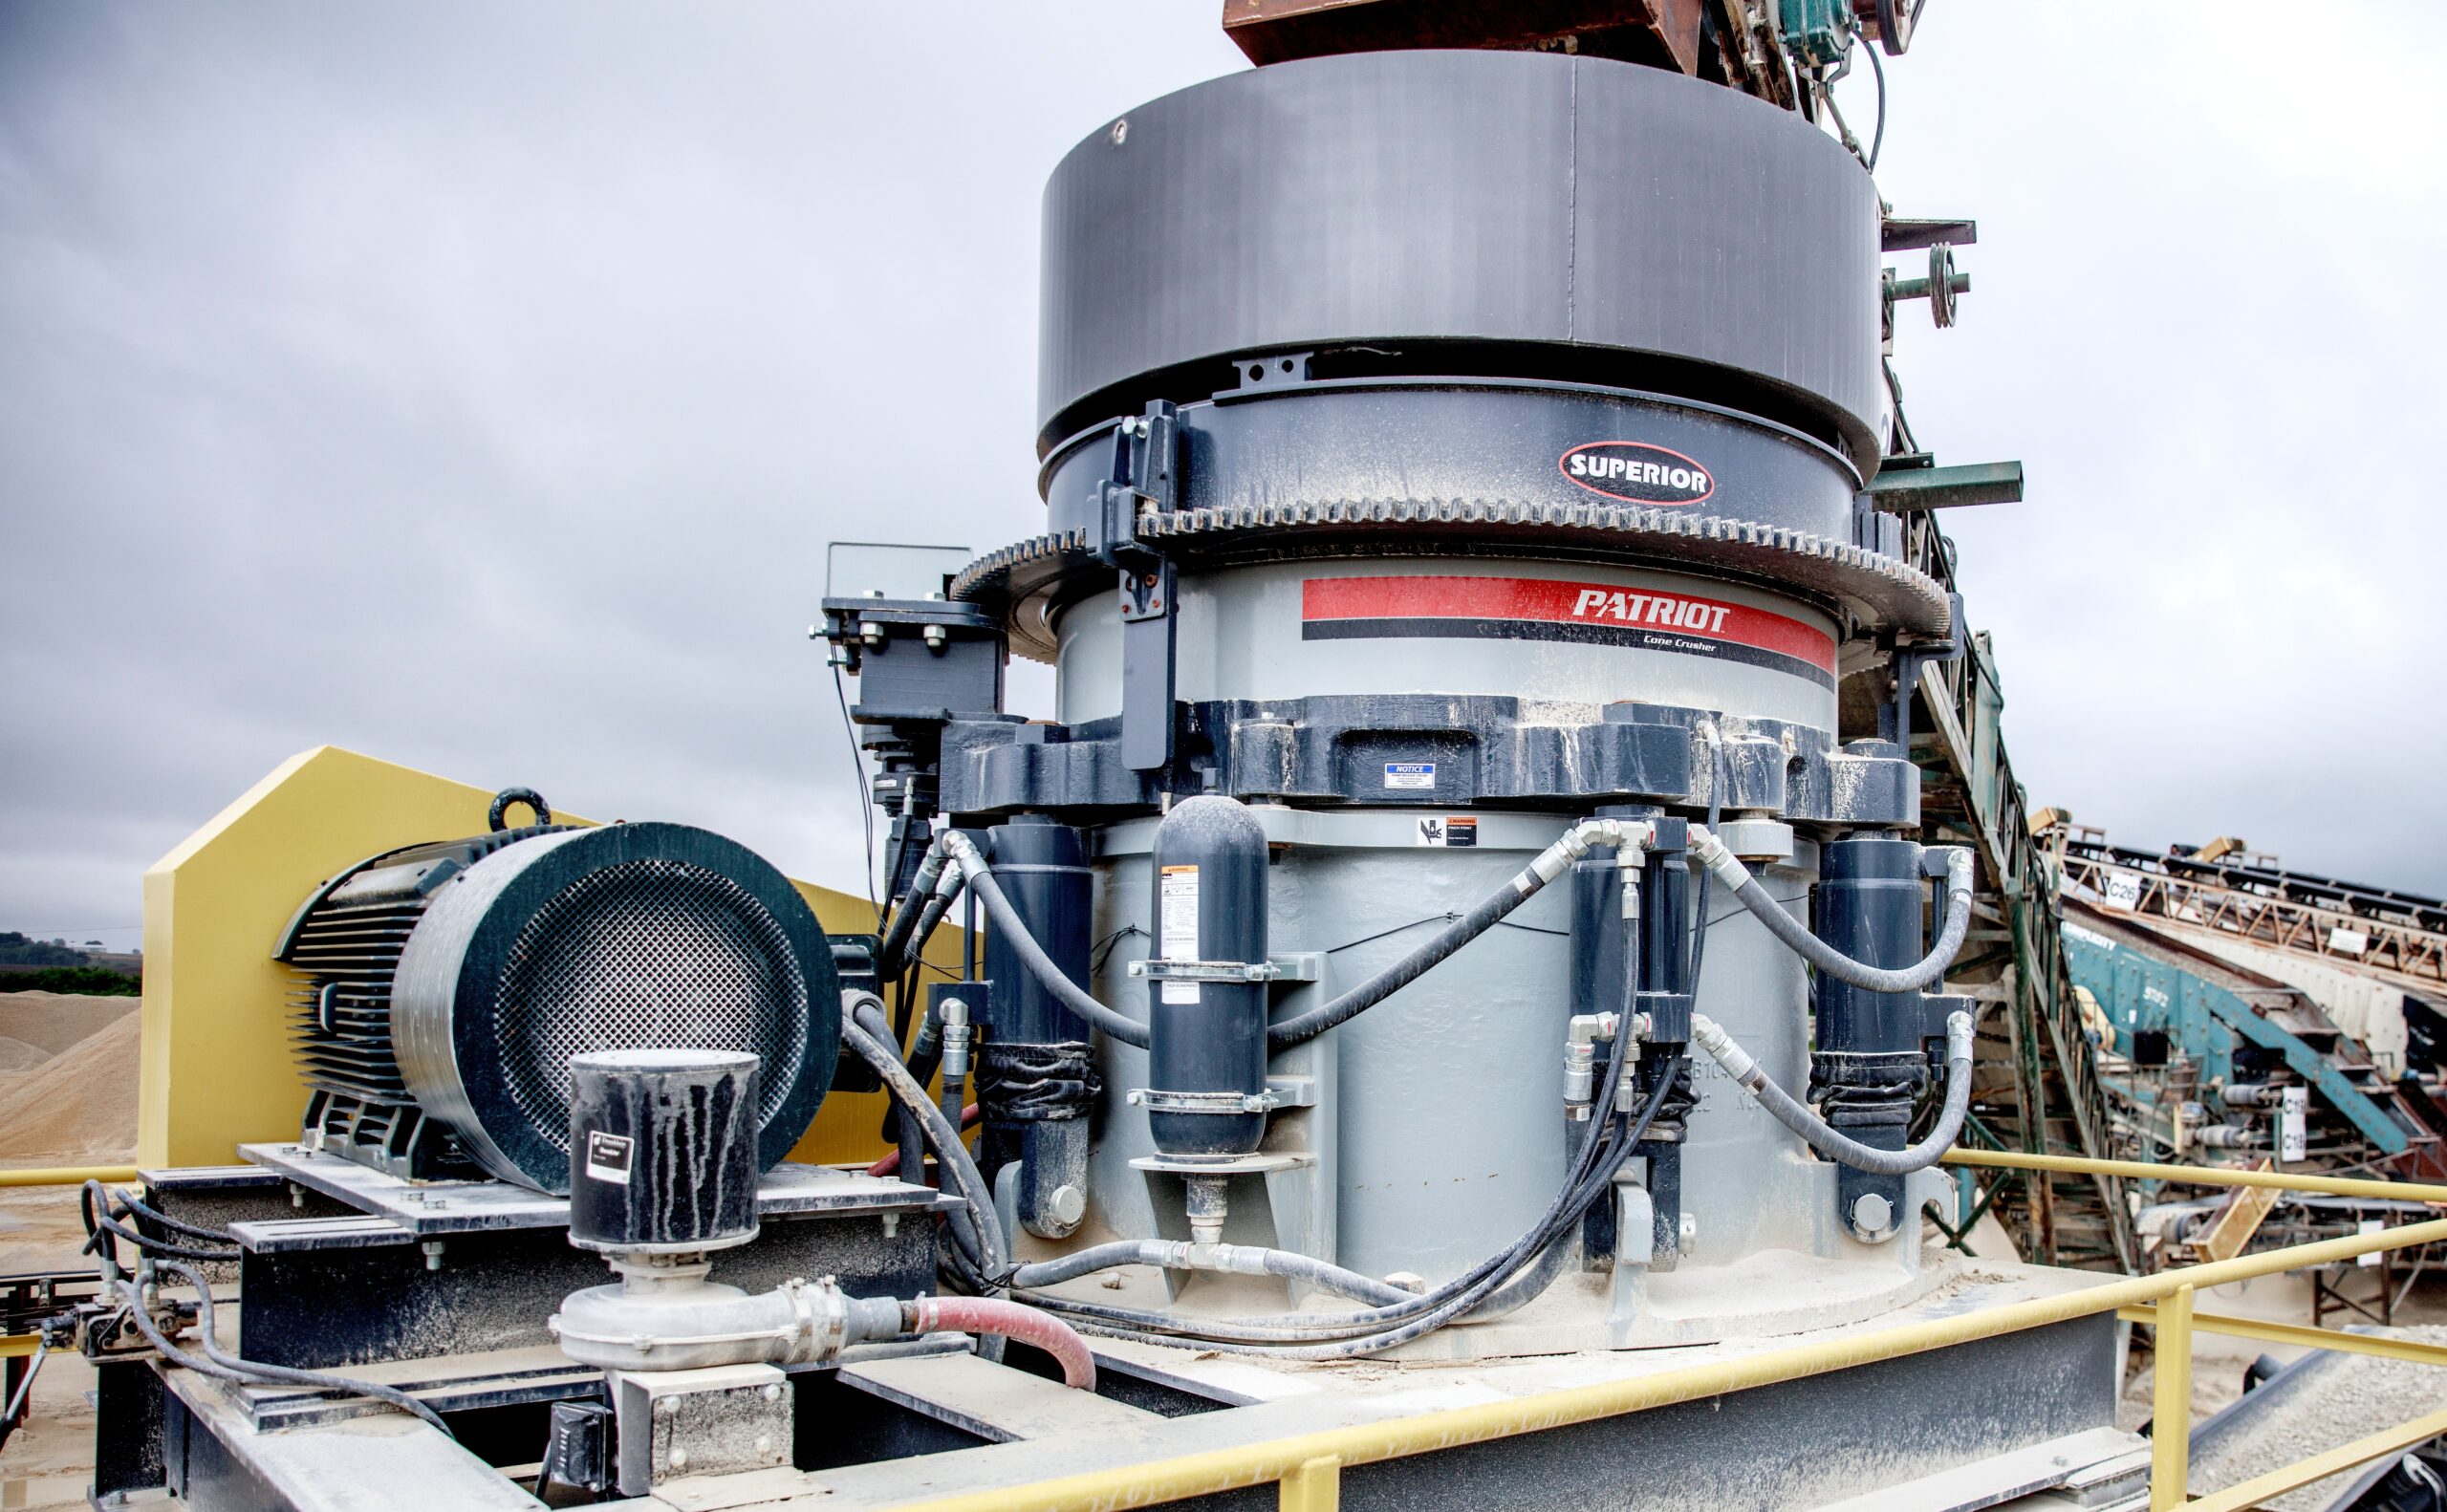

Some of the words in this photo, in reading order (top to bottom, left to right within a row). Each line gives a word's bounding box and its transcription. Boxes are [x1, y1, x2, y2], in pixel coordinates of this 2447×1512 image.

[1570, 454, 1707, 493] SUPERIOR
[1572, 589, 1731, 632] PATRIOT
[1644, 635, 1673, 646] Cone
[1675, 638, 1717, 652] Crusher
[2110, 882, 2135, 900] C26
